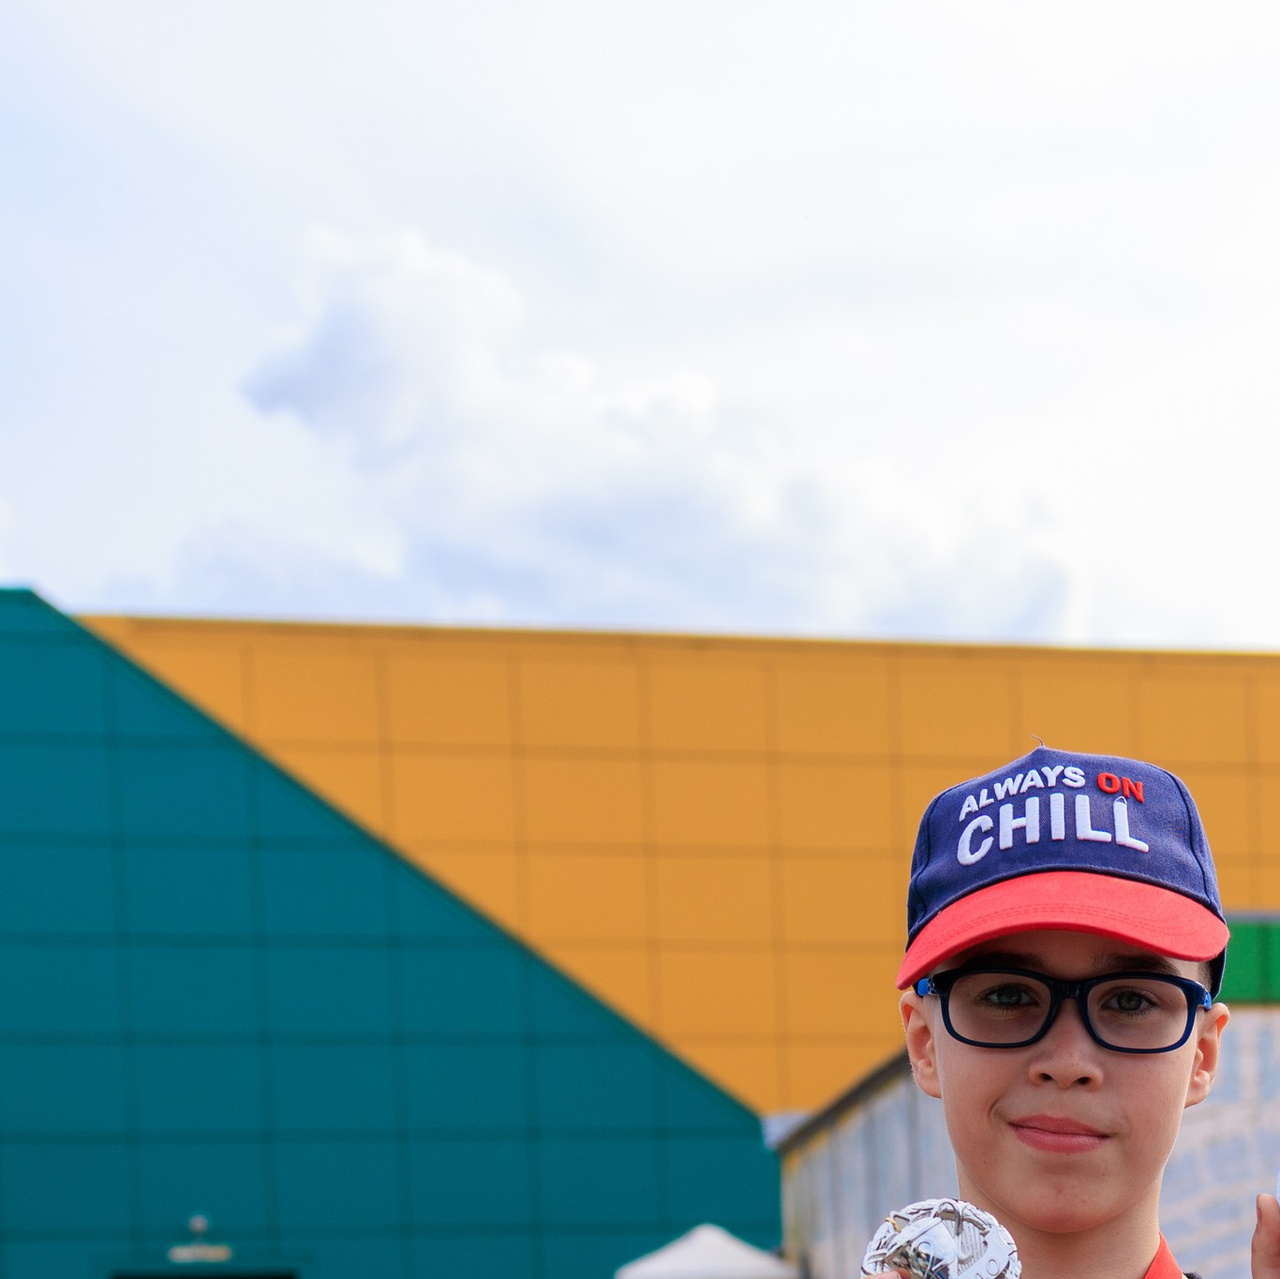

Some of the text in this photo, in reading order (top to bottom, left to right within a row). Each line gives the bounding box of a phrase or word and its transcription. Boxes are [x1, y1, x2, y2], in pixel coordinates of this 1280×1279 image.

[958, 765, 1145, 822] ALWAYS ON
[956, 792, 1150, 866] CHILL
